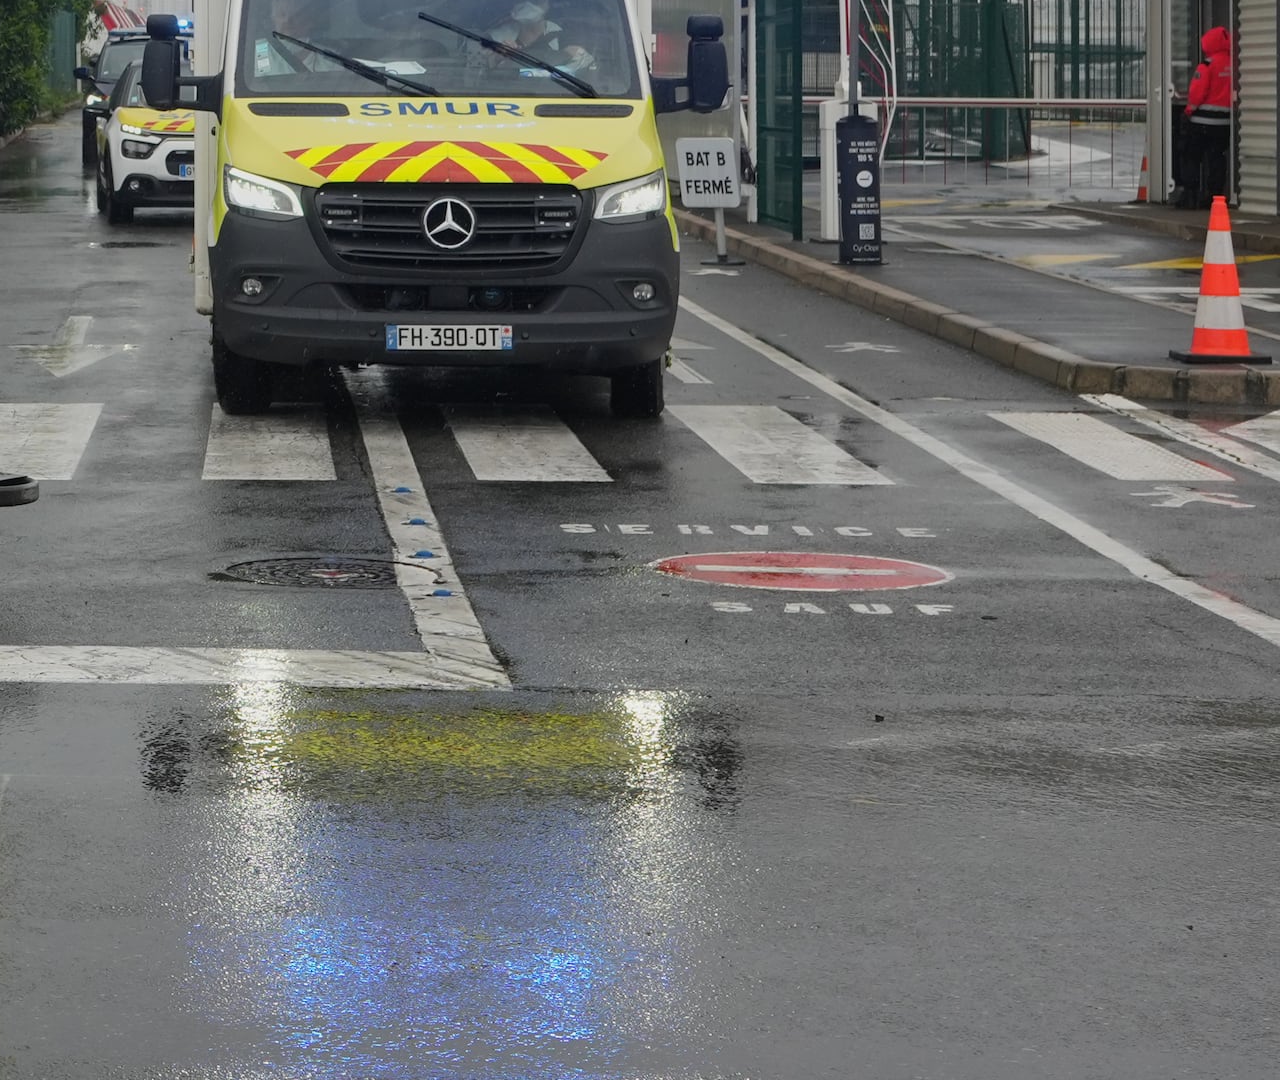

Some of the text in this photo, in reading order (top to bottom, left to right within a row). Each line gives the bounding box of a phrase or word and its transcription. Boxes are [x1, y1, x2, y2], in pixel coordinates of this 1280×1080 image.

[360, 102, 524, 117] SMUR
[685, 151, 726, 167] BAT B
[685, 176, 733, 195] FERMÉ
[398, 327, 500, 347] FH-390-QT
[558, 522, 937, 539] SERVICE
[710, 601, 955, 617] SAUF
